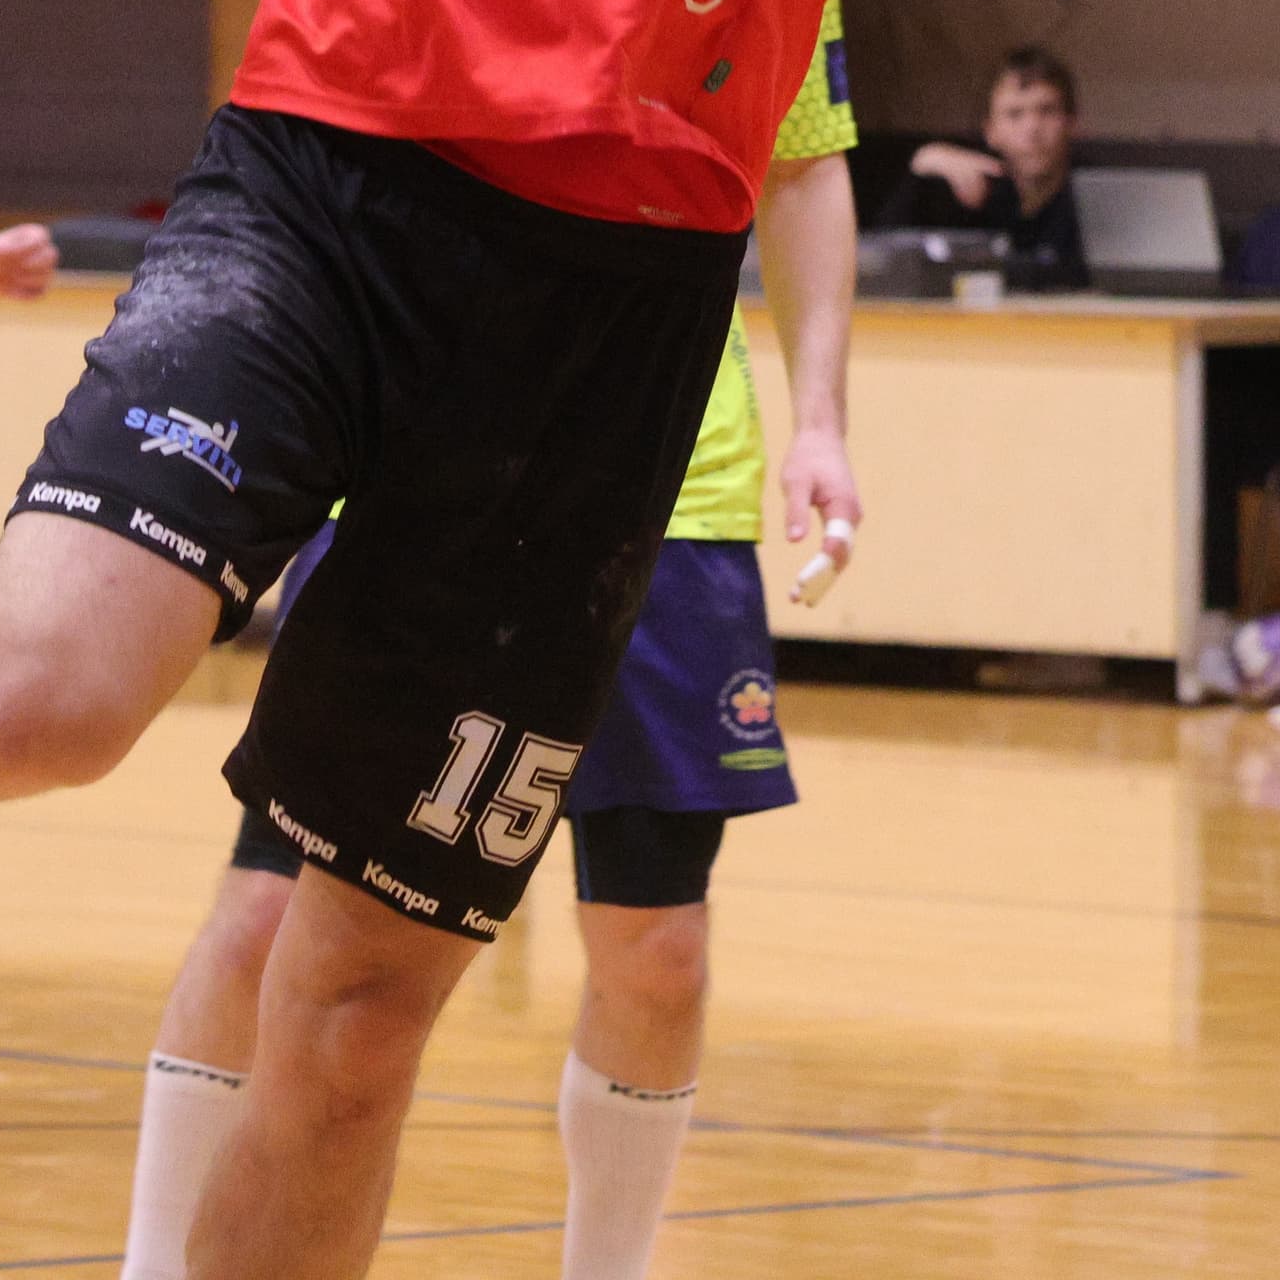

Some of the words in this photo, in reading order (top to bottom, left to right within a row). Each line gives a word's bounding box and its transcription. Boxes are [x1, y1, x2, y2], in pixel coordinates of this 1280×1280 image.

[124, 405, 242, 487] SERVITI
[28, 481, 101, 514] Kempa
[129, 507, 207, 567] Kempa
[220, 559, 249, 604] Kempa
[406, 709, 584, 868] 15
[269, 797, 338, 864] Kempa
[362, 858, 439, 916] Kempa
[461, 905, 504, 939] Kem
